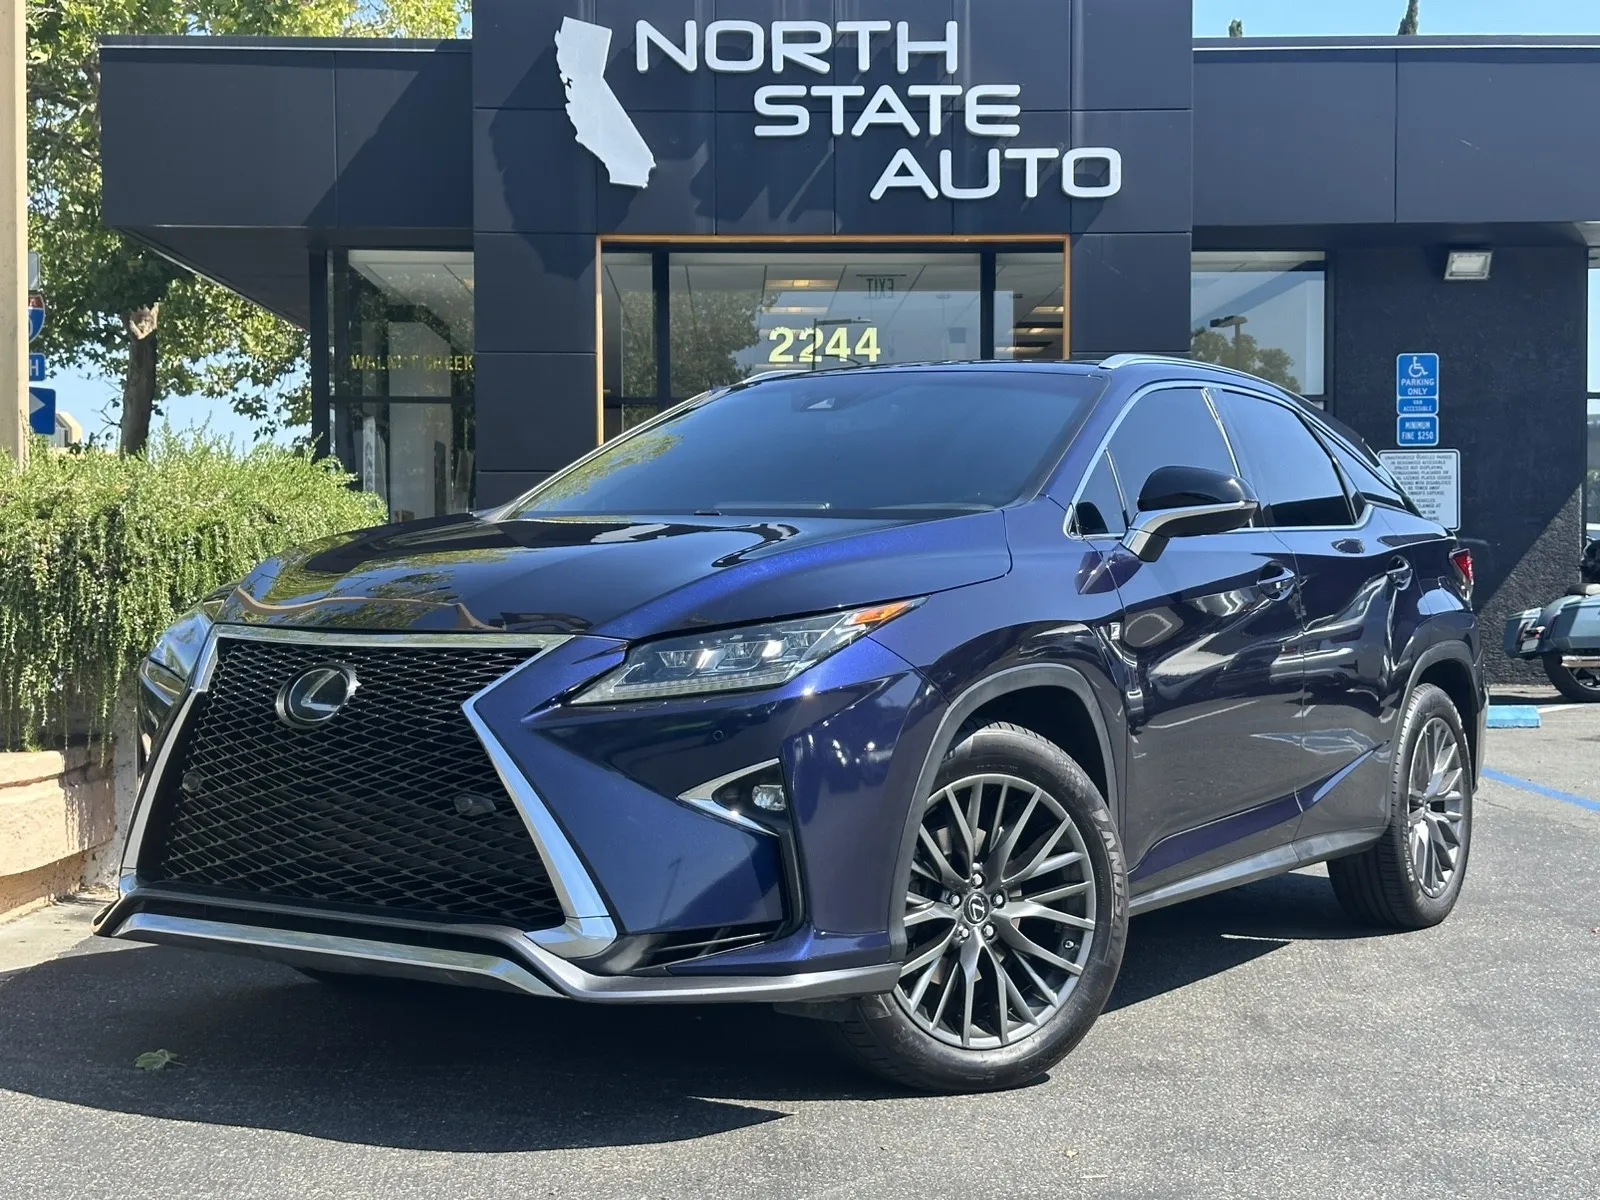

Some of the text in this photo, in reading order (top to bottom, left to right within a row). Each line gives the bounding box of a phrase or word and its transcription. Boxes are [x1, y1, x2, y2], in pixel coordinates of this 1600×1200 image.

[635, 19, 958, 74] NORTH
[754, 84, 1021, 137] STATE
[870, 147, 1122, 200] AUTO
[768, 326, 881, 363] 2244
[1401, 378, 1435, 386] PARKING
[1401, 431, 1434, 440] FINE $250
[1404, 421, 1431, 430] MINIMUM
